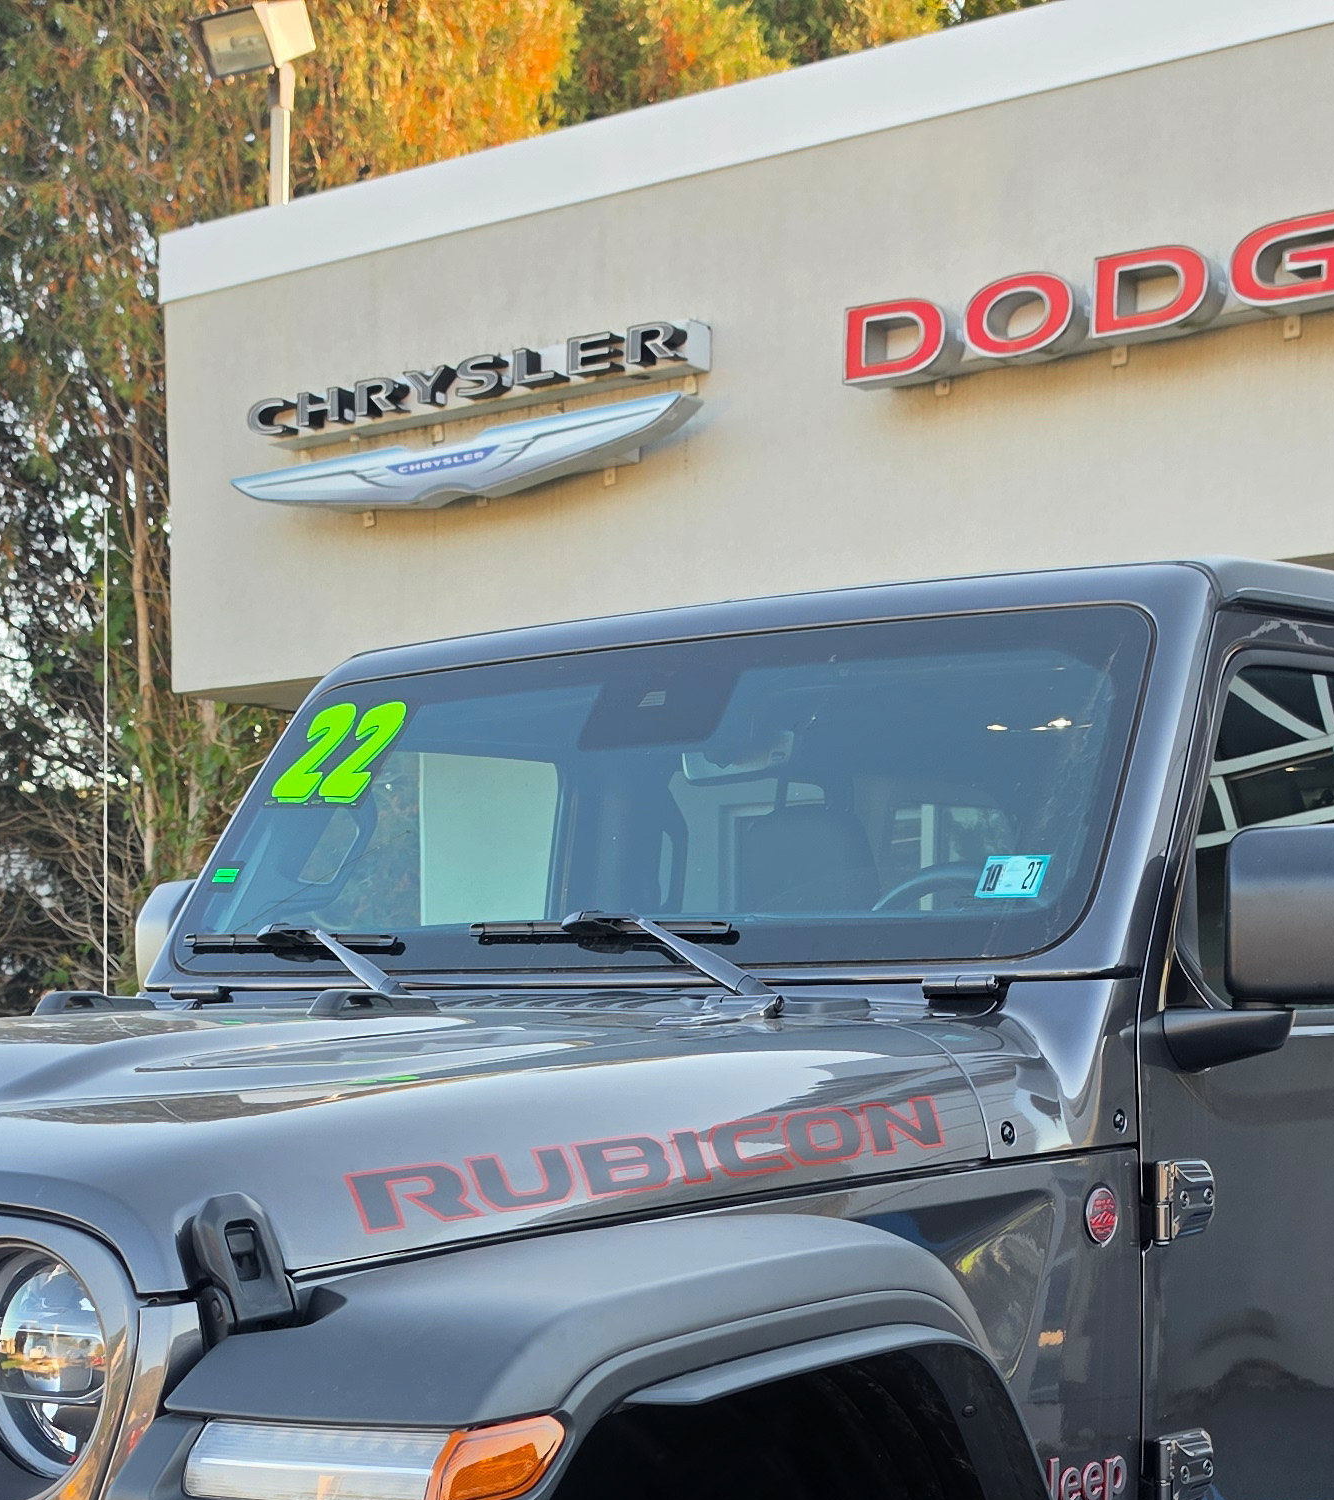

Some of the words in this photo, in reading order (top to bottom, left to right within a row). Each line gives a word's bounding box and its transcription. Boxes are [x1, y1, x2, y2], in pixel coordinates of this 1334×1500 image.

[246, 320, 688, 438] CHRYSLER
[397, 450, 485, 474] CHRYSLER
[271, 700, 408, 804] 22
[980, 863, 1004, 892] 10
[1020, 861, 1043, 890] 27
[344, 1096, 946, 1235] RUBICON
